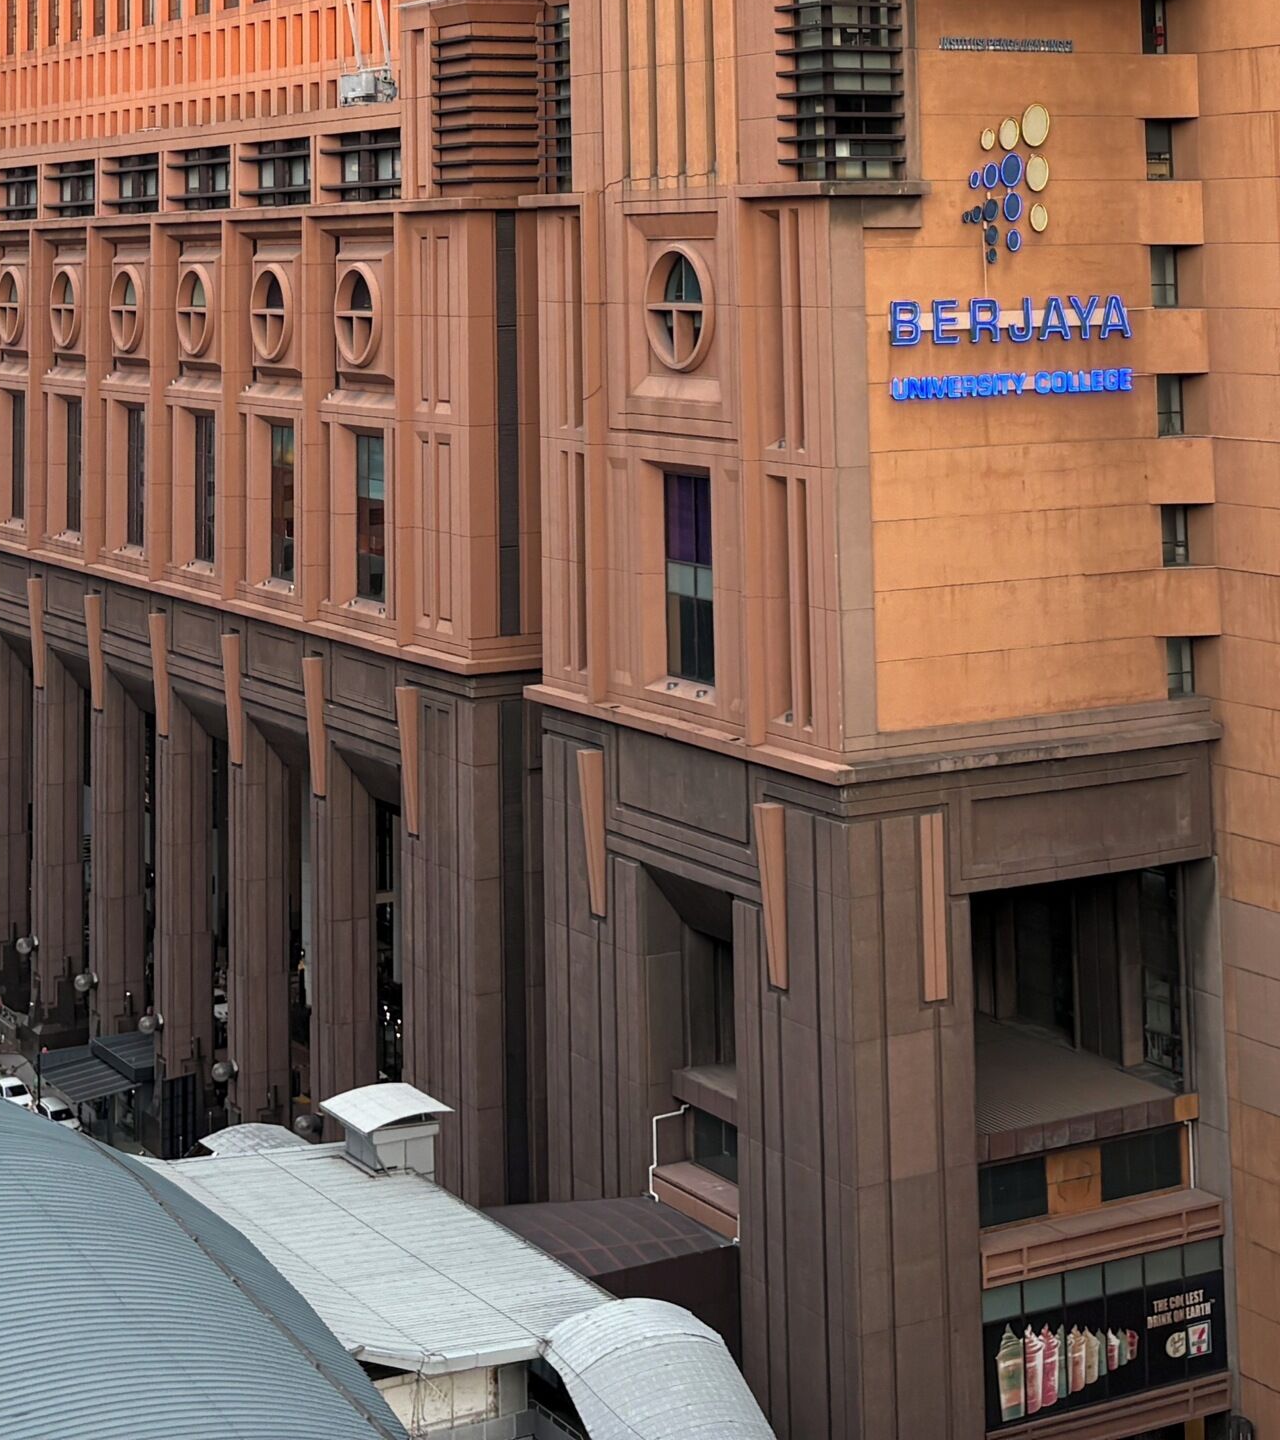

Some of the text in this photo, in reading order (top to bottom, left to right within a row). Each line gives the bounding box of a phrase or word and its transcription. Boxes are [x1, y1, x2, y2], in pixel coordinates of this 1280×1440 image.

[890, 295, 1132, 346] BERJAYA
[892, 367, 1133, 401] UNIVERSITY COLLEGE
[1153, 1298, 1169, 1313] THE
